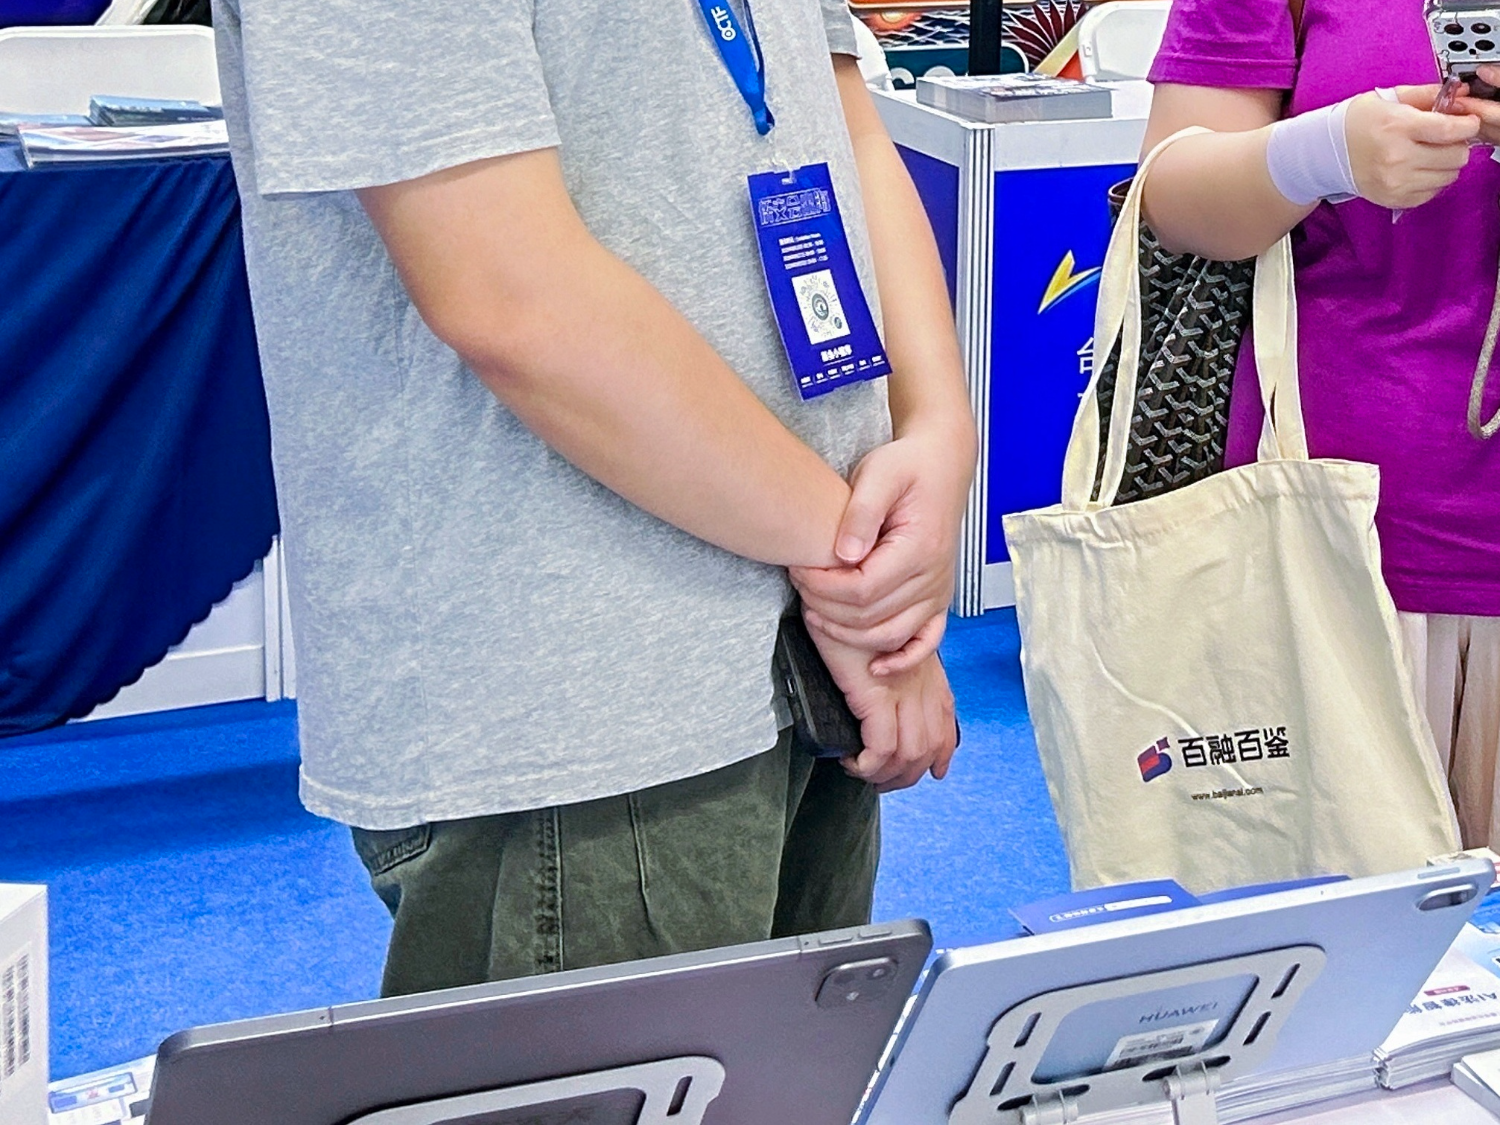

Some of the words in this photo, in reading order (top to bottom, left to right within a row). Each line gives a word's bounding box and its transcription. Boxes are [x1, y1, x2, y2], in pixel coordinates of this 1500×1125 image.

[1178, 726, 1291, 768] 百融百鉴
[1138, 1001, 1219, 1024] HUAWEI
